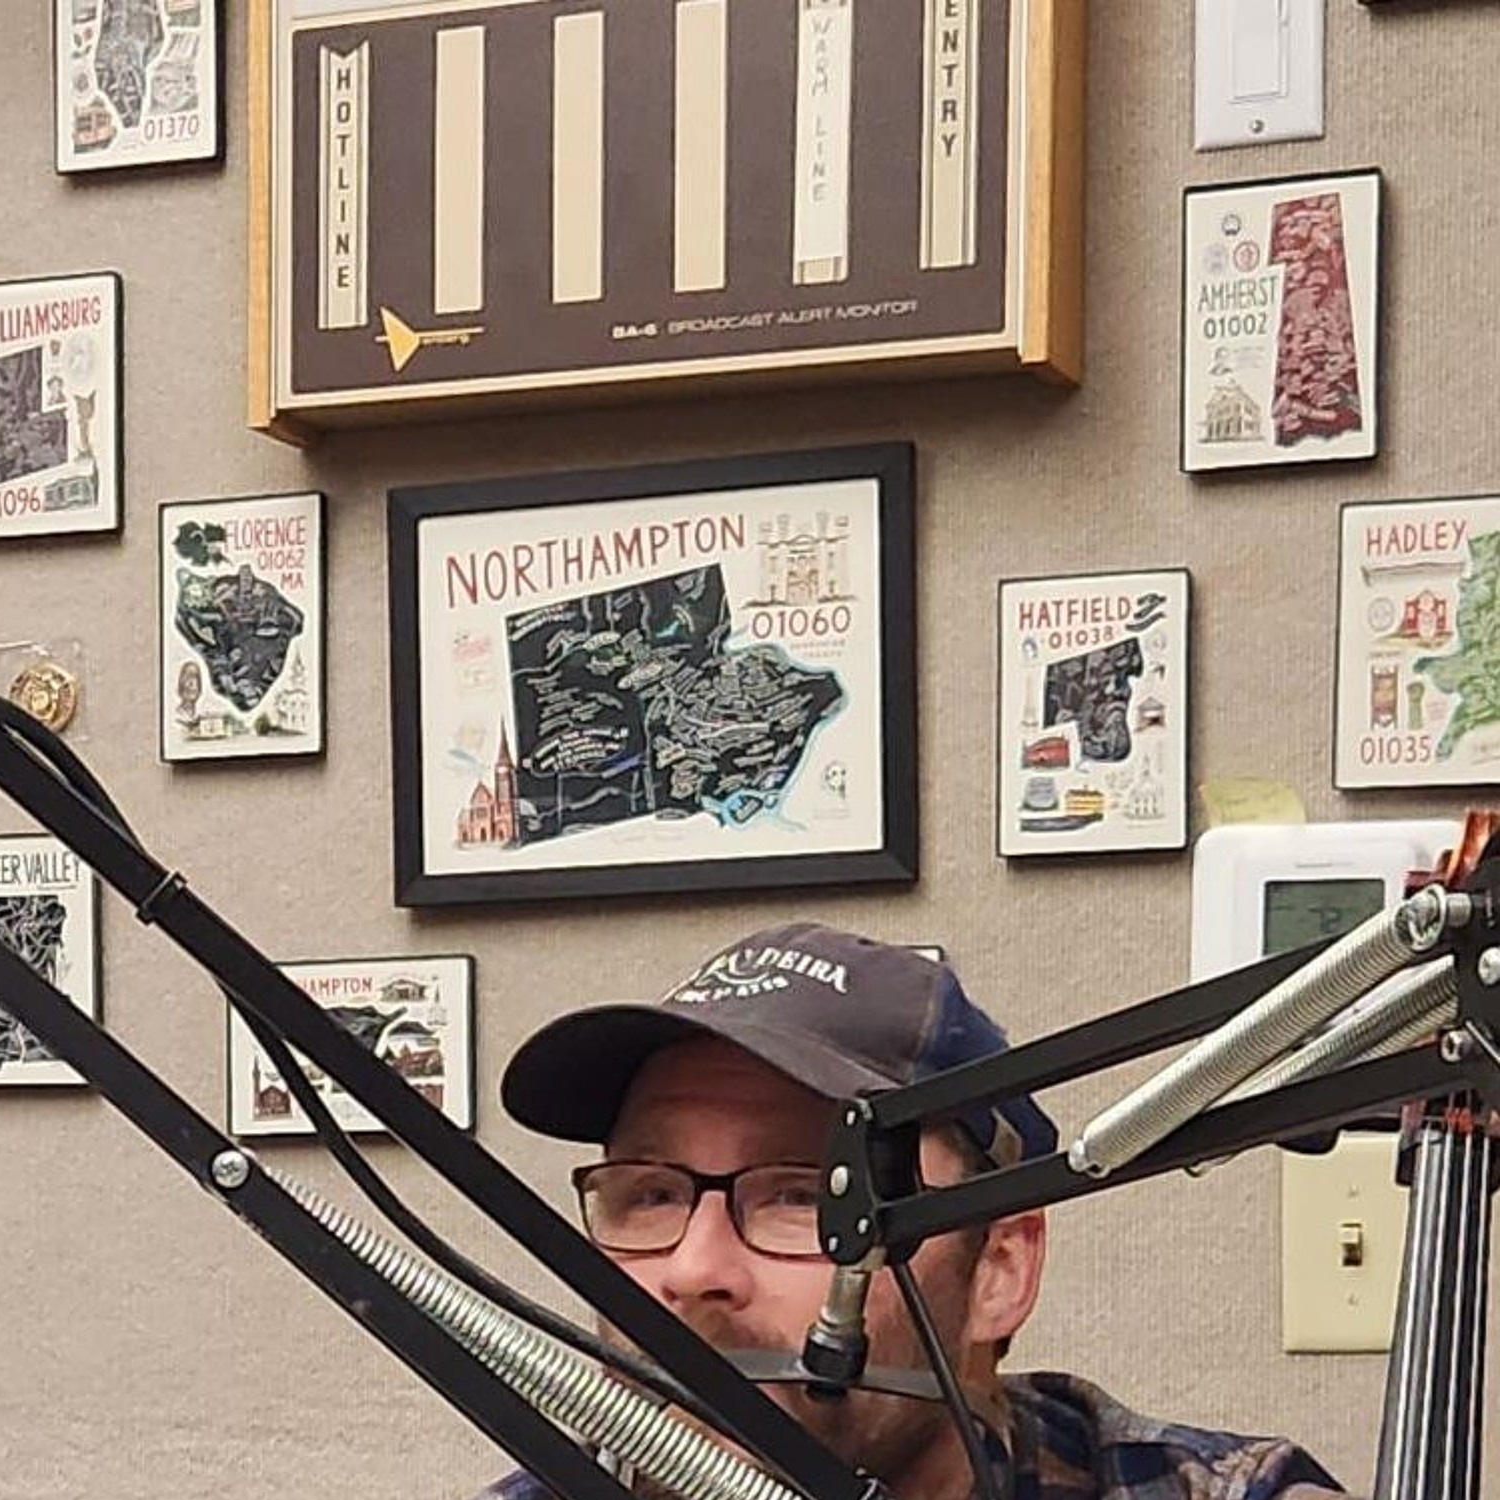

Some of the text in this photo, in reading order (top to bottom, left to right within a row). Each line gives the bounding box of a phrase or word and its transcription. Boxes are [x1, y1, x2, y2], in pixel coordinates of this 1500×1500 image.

[142, 114, 200, 142] 01370
[811, 114, 828, 203] LINE
[335, 67, 351, 288] HOTLINE
[1197, 276, 1278, 313] AMHERST
[668, 311, 773, 335] BROADCAST
[777, 307, 832, 325] ALERT
[835, 299, 919, 320] MONITOR
[1203, 312, 1267, 339] 01002
[224, 515, 307, 552] FLORENCE
[1365, 520, 1467, 556] HADLEY
[257, 549, 308, 571] 01062
[445, 513, 746, 609] NORTHAMPTON
[281, 571, 304, 590] MA
[752, 604, 852, 640] 01060
[1018, 596, 1132, 632] HATFIELD
[1048, 625, 1115, 650] 01038
[1360, 736, 1432, 766] 01035
[23, 851, 81, 883] VALLEY
